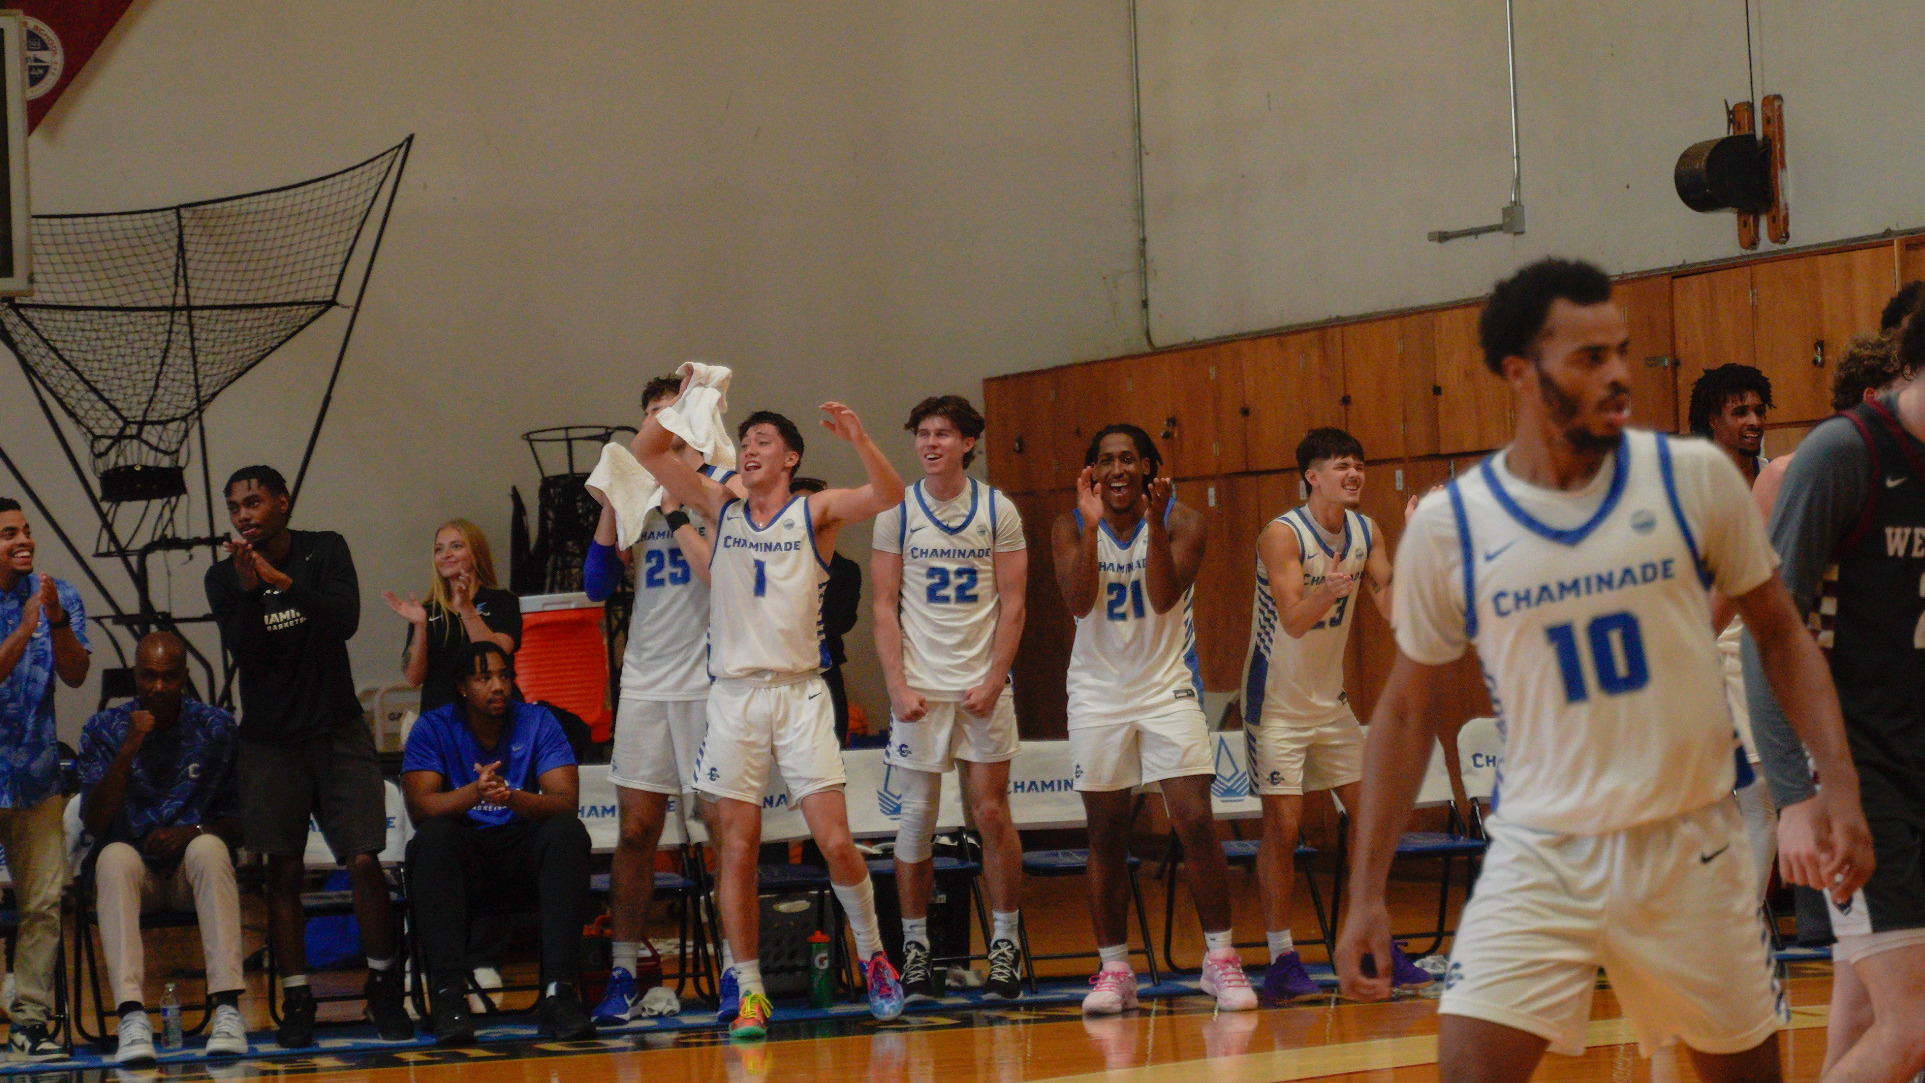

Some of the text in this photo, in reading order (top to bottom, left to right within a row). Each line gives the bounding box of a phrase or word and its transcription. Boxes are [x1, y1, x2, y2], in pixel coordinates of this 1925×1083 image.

[723, 535, 801, 553] CHAMINADE
[910, 546, 991, 559] CHAMINADE
[645, 548, 691, 589] 25
[753, 558, 766, 598] 1
[926, 567, 979, 604] 22
[1491, 557, 1676, 618] CHAMINADE
[1106, 578, 1146, 622] 21
[1544, 610, 1651, 704] 10
